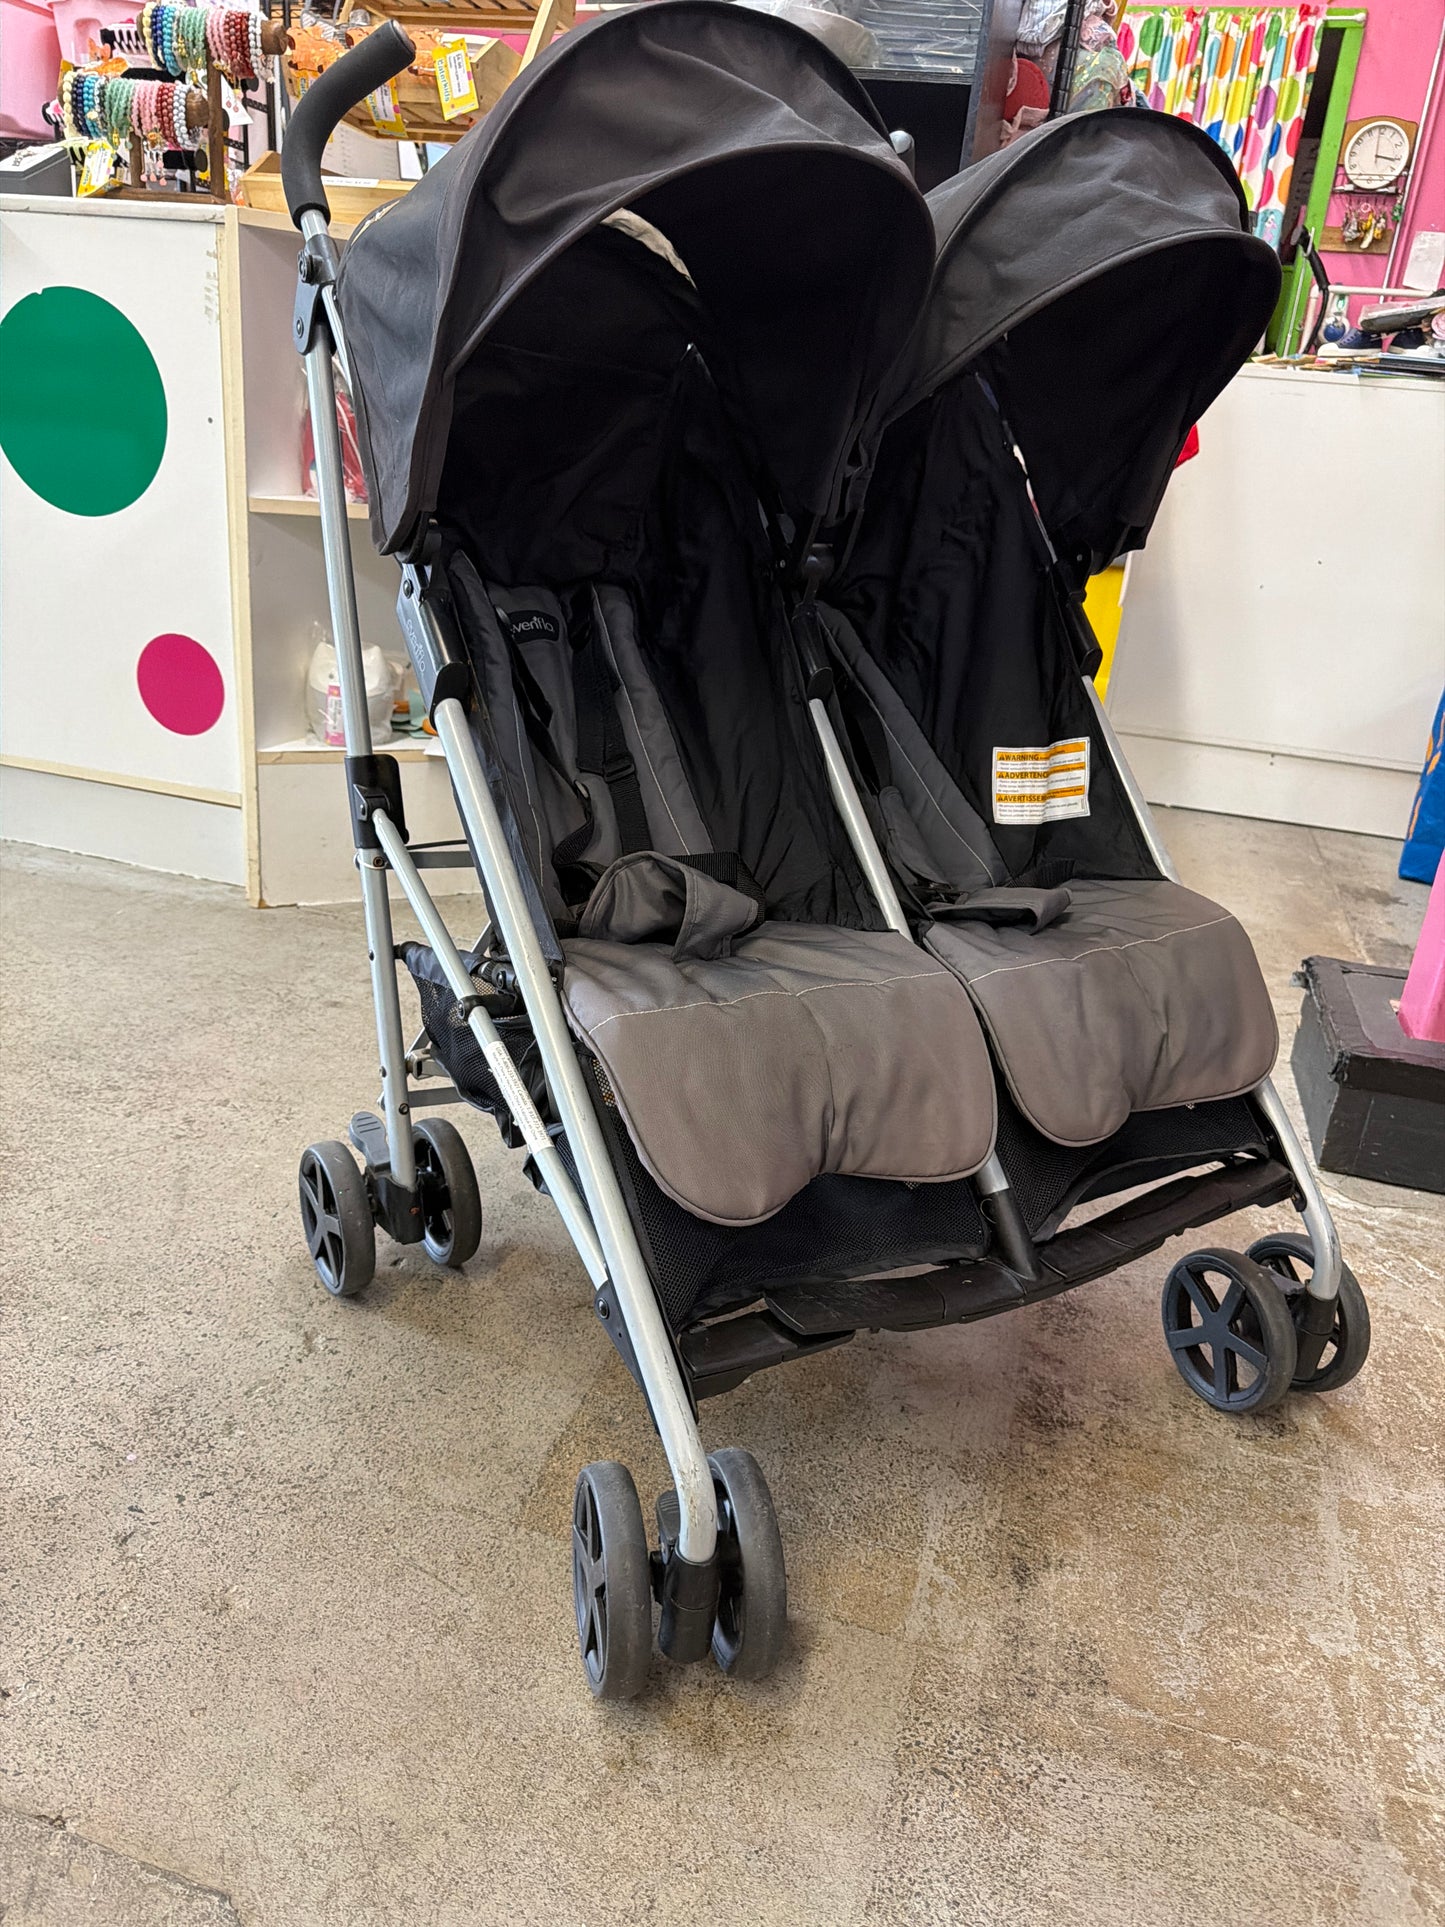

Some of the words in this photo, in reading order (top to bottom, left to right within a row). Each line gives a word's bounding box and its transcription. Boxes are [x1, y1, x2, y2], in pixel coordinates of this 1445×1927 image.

[1395, 141, 1403, 149] 2
[511, 616, 554, 636] venflo
[406, 619, 426, 673] evenflo
[1004, 753, 1039, 761] WARNING
[1004, 771, 1050, 779] ADVERTENC
